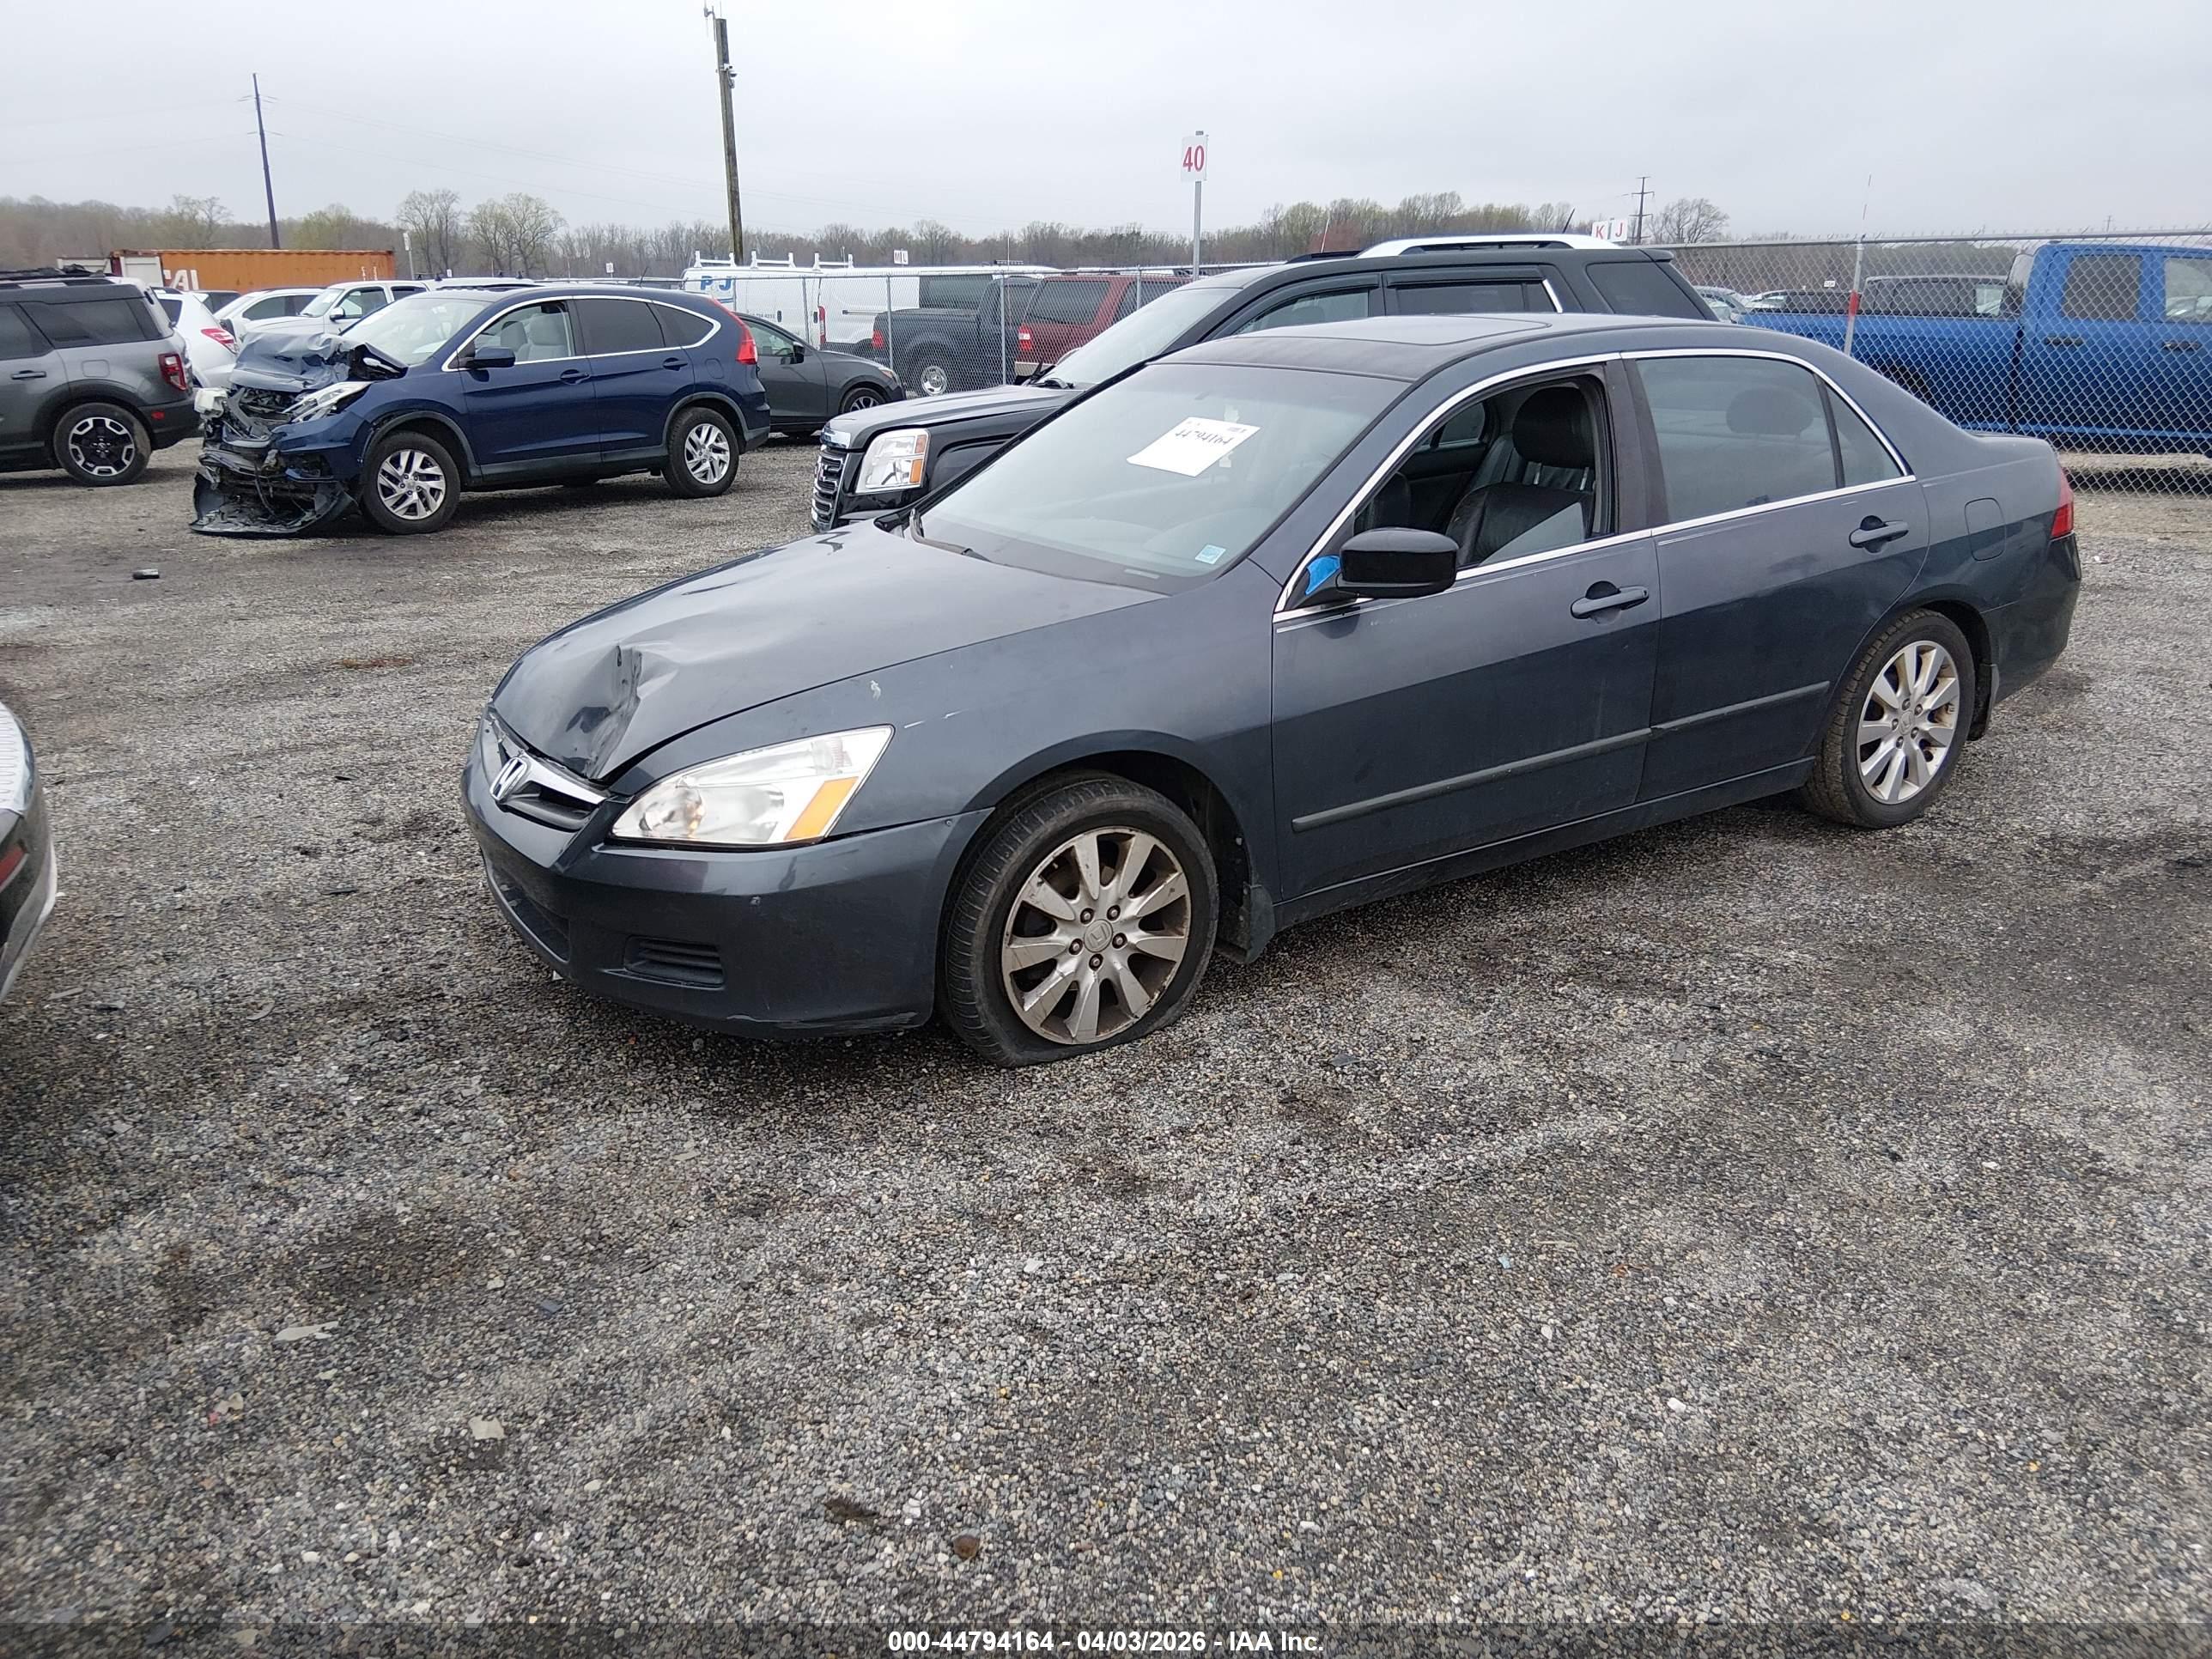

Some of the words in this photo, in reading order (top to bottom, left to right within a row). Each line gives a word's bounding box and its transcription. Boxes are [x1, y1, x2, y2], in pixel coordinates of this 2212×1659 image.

[1182, 145, 1205, 173] 40
[1595, 225, 1605, 240] K
[1615, 222, 1623, 237] J
